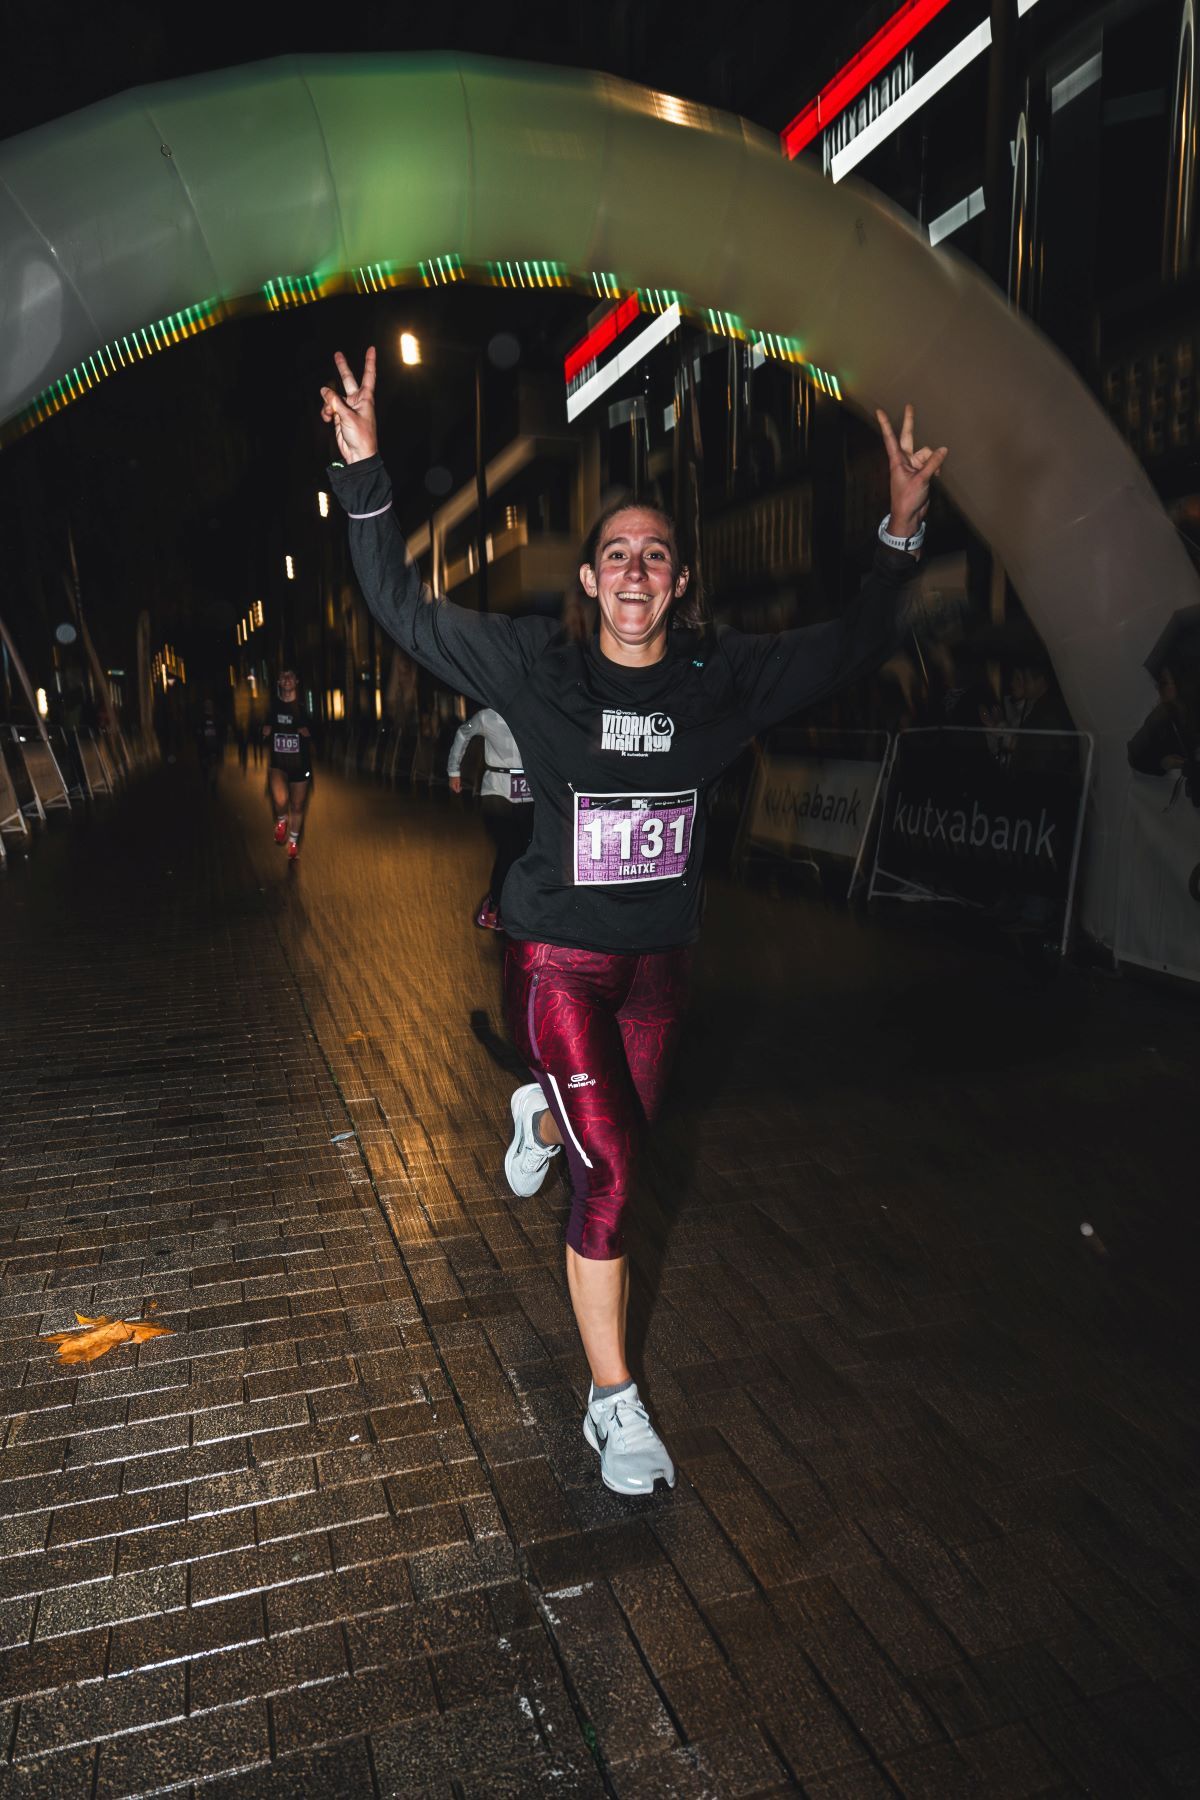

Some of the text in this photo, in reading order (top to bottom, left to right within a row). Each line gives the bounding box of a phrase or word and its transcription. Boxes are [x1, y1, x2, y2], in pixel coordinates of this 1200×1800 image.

[602, 713, 652, 736] VITORIA
[276, 738, 298, 748] 1105
[601, 732, 672, 752] NIGHT RUN
[512, 779, 531, 793] 12
[762, 783, 862, 826] kutxabank
[892, 791, 1057, 859] kutxabank
[583, 814, 685, 860] 1131
[619, 862, 656, 876] IRATXE
